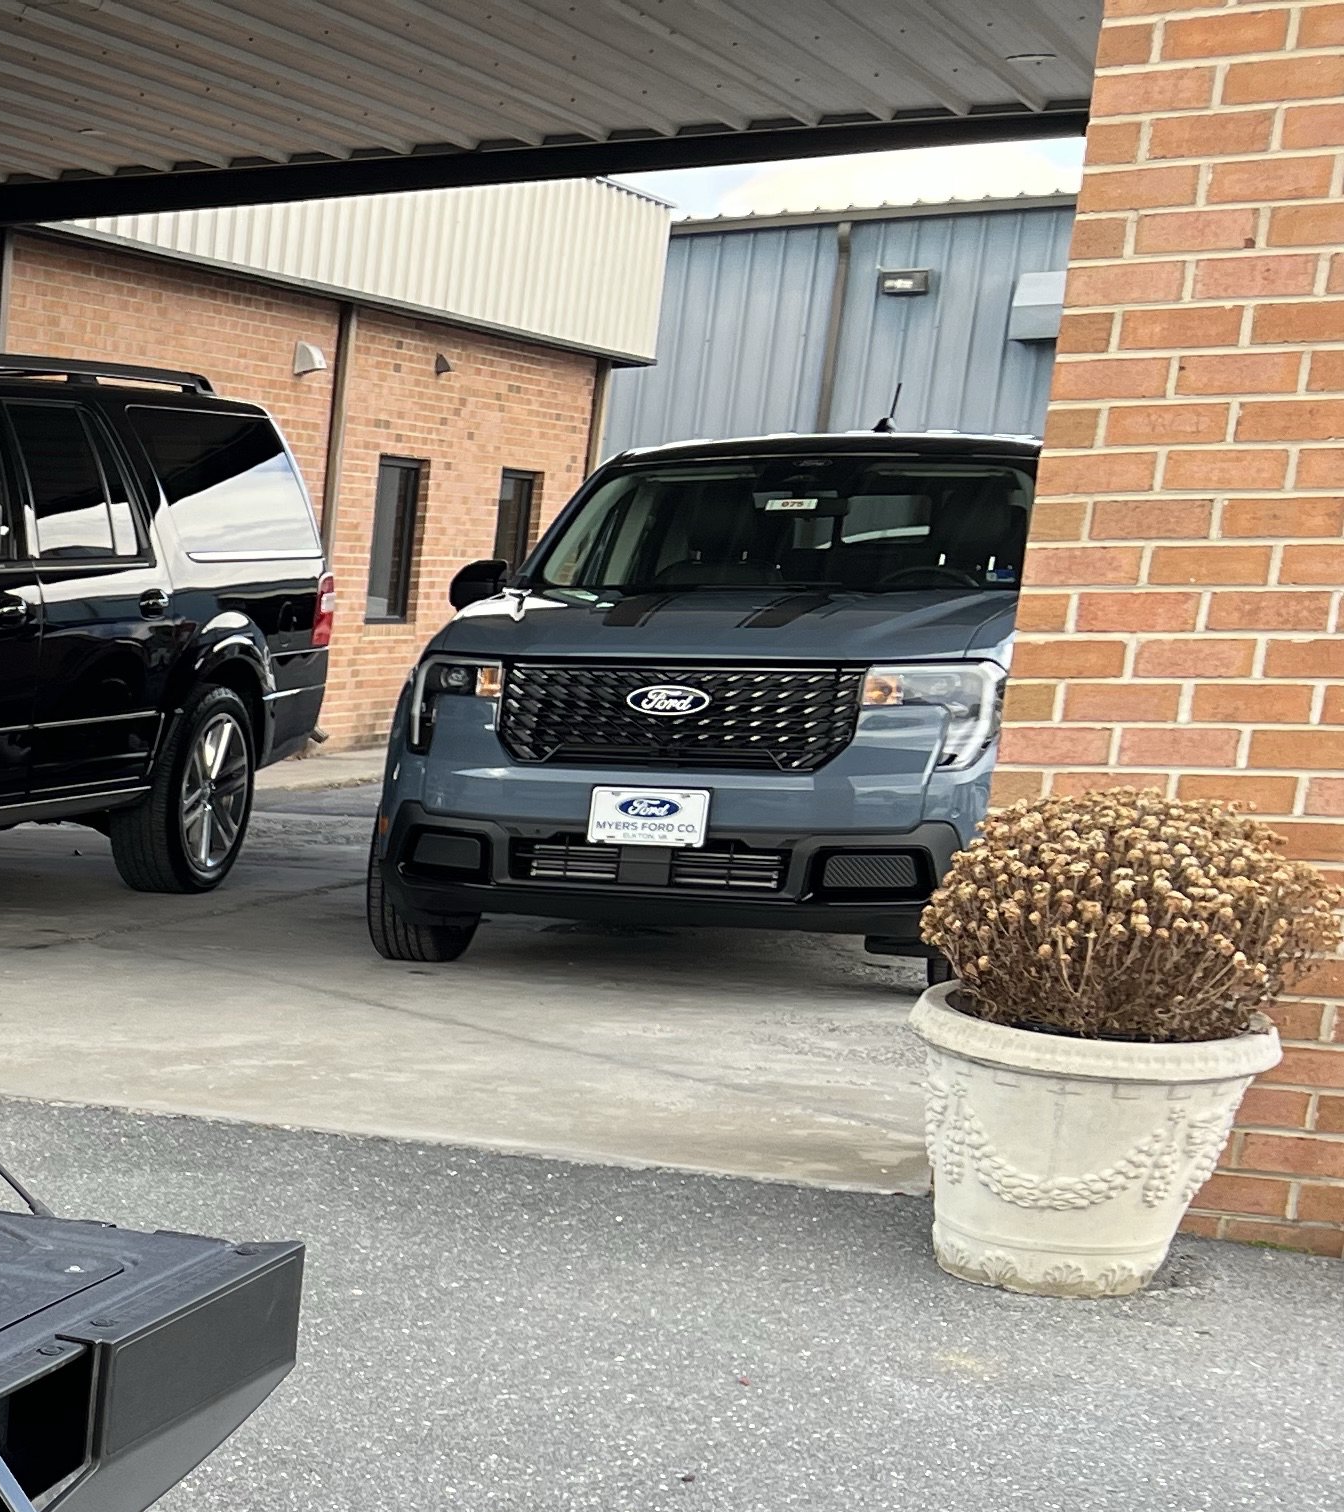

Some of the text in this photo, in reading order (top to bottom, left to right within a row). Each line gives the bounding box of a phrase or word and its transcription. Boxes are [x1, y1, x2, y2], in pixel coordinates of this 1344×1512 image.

[640, 689, 694, 711] Ford
[627, 799, 671, 817] Ford
[596, 820, 698, 834] MYERS FORD CO.
